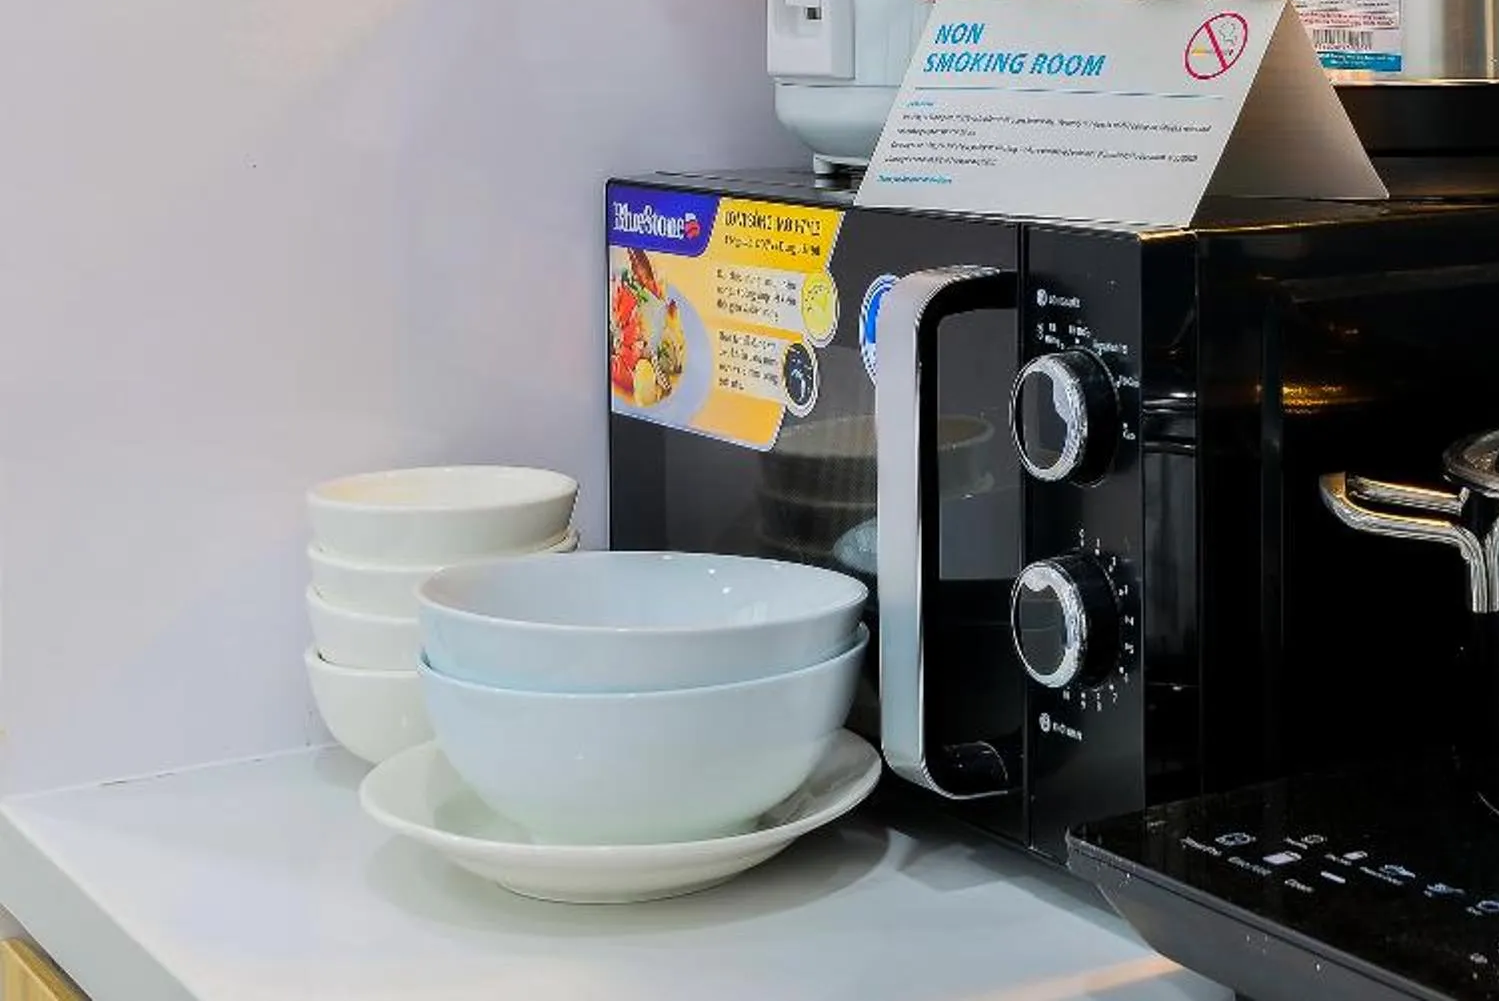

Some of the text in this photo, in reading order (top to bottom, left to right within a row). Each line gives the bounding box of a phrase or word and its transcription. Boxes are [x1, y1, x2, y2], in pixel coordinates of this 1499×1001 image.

[934, 22, 985, 45] NON
[923, 51, 1107, 77] SMOKING ROOM
[612, 201, 685, 240] BlueStone
